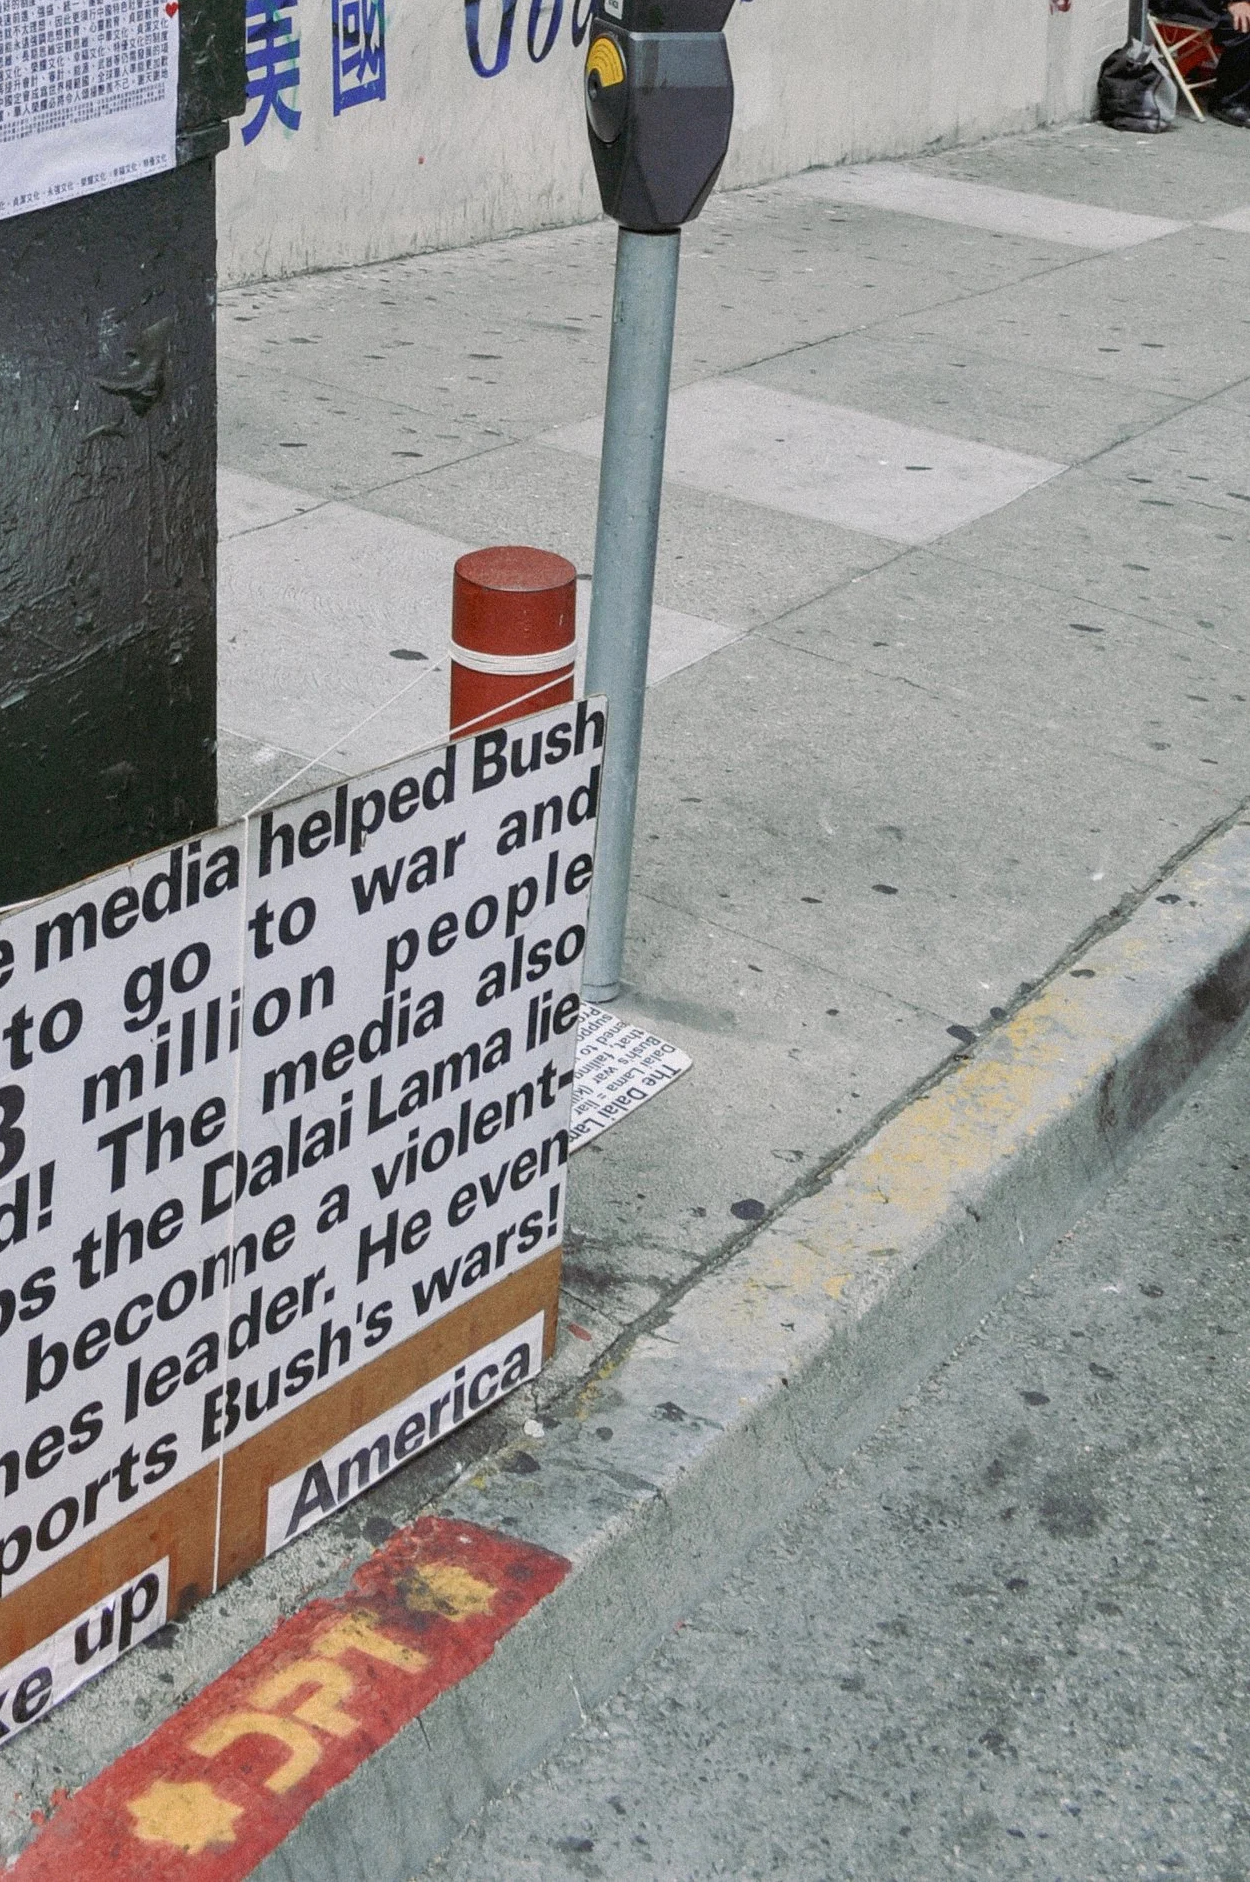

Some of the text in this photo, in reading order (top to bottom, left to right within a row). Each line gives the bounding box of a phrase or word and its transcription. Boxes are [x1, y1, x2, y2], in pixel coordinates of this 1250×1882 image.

[35, 840, 239, 972] media
[259, 744, 456, 877] helped
[473, 700, 607, 793] Bush
[83, 966, 334, 1123] million
[385, 851, 593, 994] people
[640, 1043, 676, 1067] Dalai
[73, 1199, 183, 1289] the
[201, 1090, 353, 1224] Dalai
[368, 1028, 511, 1135] Lama
[526, 990, 580, 1051] lie
[598, 1063, 682, 1121] The Dalai
[606, 1067, 644, 1092] Lama
[202, 1301, 392, 1451] Bush's
[413, 1184, 559, 1316] wars!
[284, 1342, 530, 1520] America
[74, 1573, 159, 1665] up
